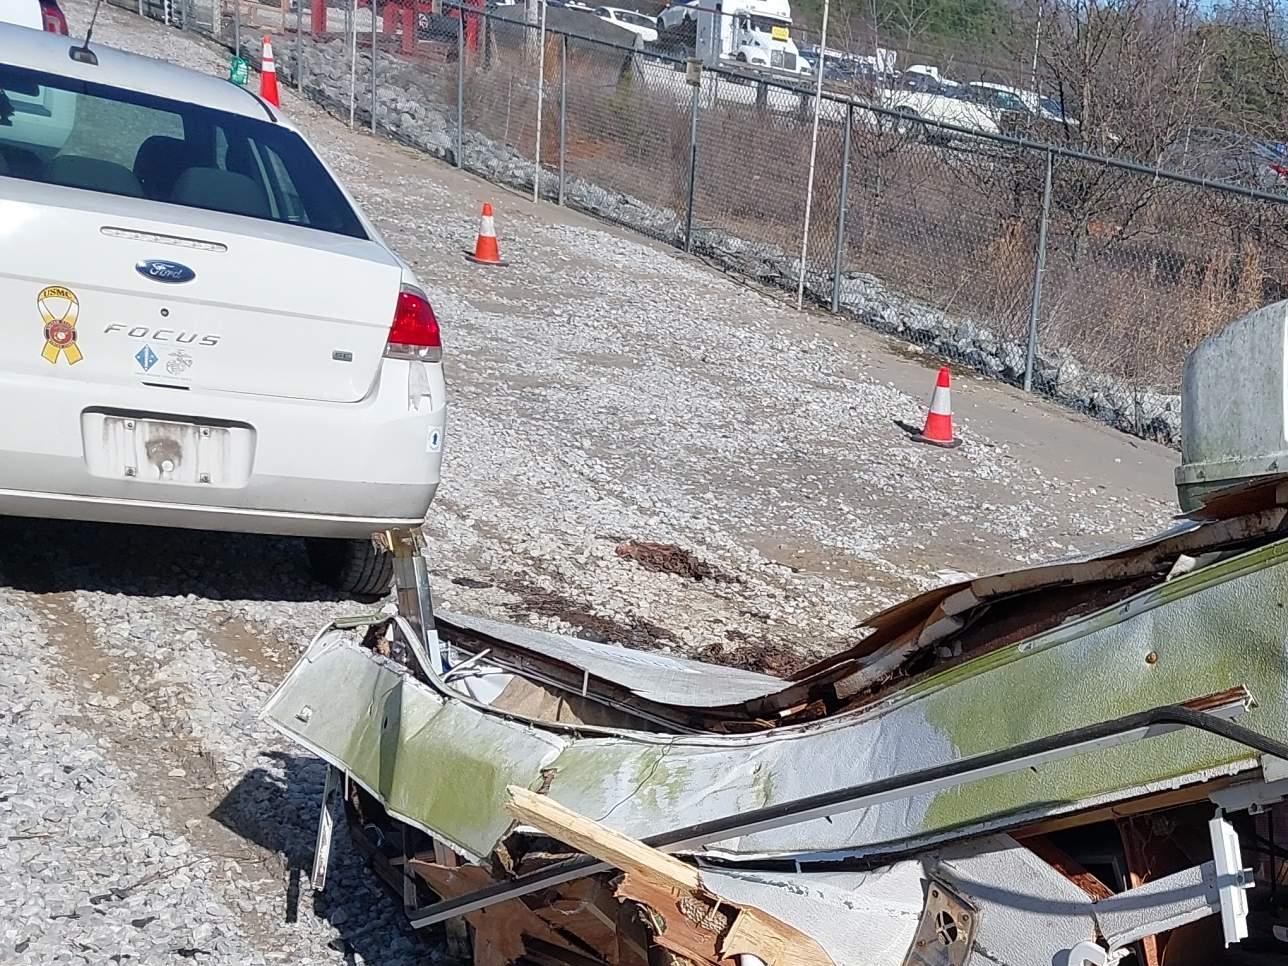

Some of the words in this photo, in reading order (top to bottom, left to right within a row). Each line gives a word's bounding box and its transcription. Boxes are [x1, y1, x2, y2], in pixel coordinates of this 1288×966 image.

[149, 262, 183, 279] Ford
[43, 288, 73, 299] USMC
[103, 323, 221, 346] FOCUS
